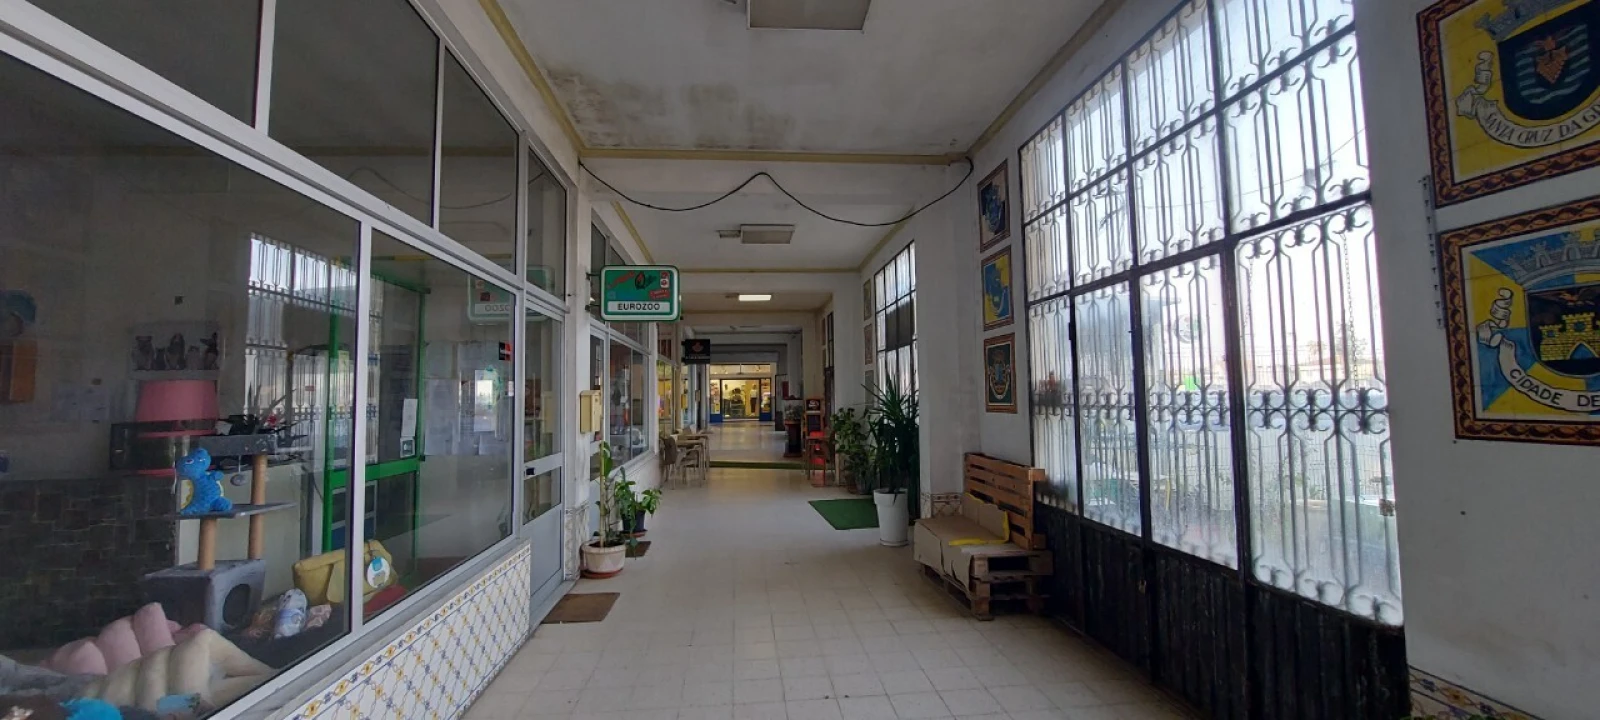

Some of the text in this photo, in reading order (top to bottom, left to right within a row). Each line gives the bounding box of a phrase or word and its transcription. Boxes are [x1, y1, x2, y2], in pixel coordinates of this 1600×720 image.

[1484, 113, 1514, 141] SANTA
[1517, 128, 1553, 144] CRUZ
[1559, 119, 1582, 138] DA
[617, 303, 660, 311] EUROZOO
[1509, 369, 1600, 407] CIDADE DE
